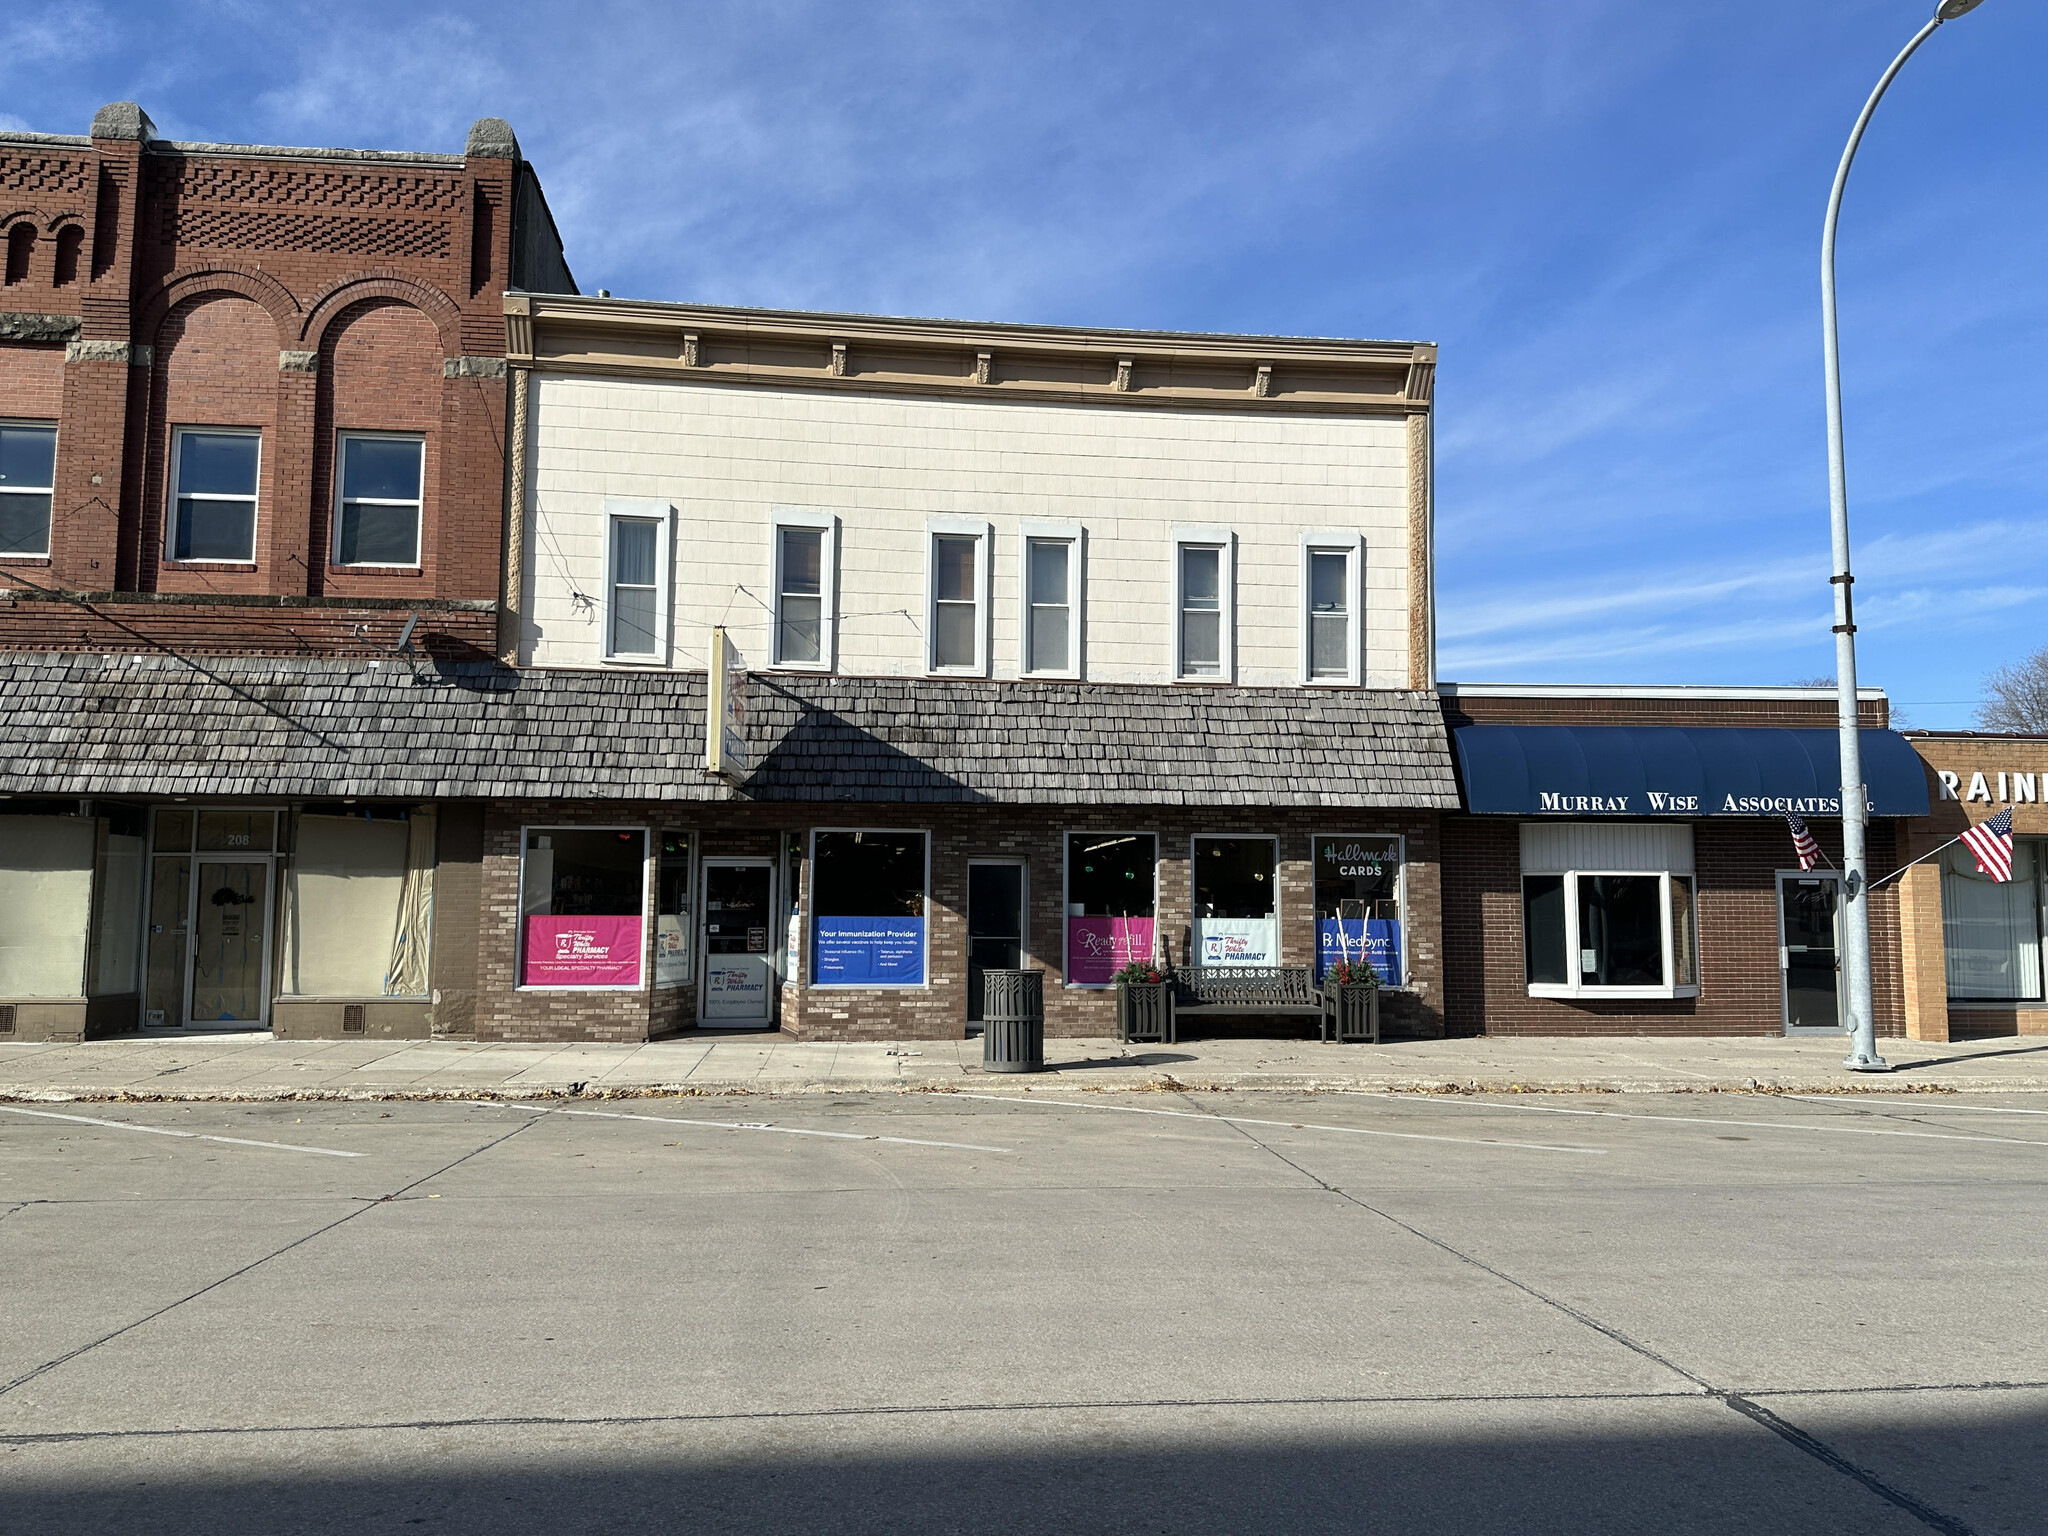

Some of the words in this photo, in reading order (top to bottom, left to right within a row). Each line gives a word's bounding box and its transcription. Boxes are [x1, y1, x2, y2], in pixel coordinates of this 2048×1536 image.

[1540, 791, 1629, 811] MURRAY
[1646, 791, 1698, 811] WISE
[1722, 793, 1839, 812] ASSOCIATES
[227, 834, 250, 846] 208
[1324, 843, 1398, 865] Hallmark
[1340, 866, 1382, 876] CARDS
[1225, 937, 1248, 946] Thrifty
[1335, 932, 1391, 951] MedSync
[572, 946, 610, 954] PHARMACY
[1225, 952, 1267, 961] PHARMACY
[727, 971, 747, 979] Thrifty
